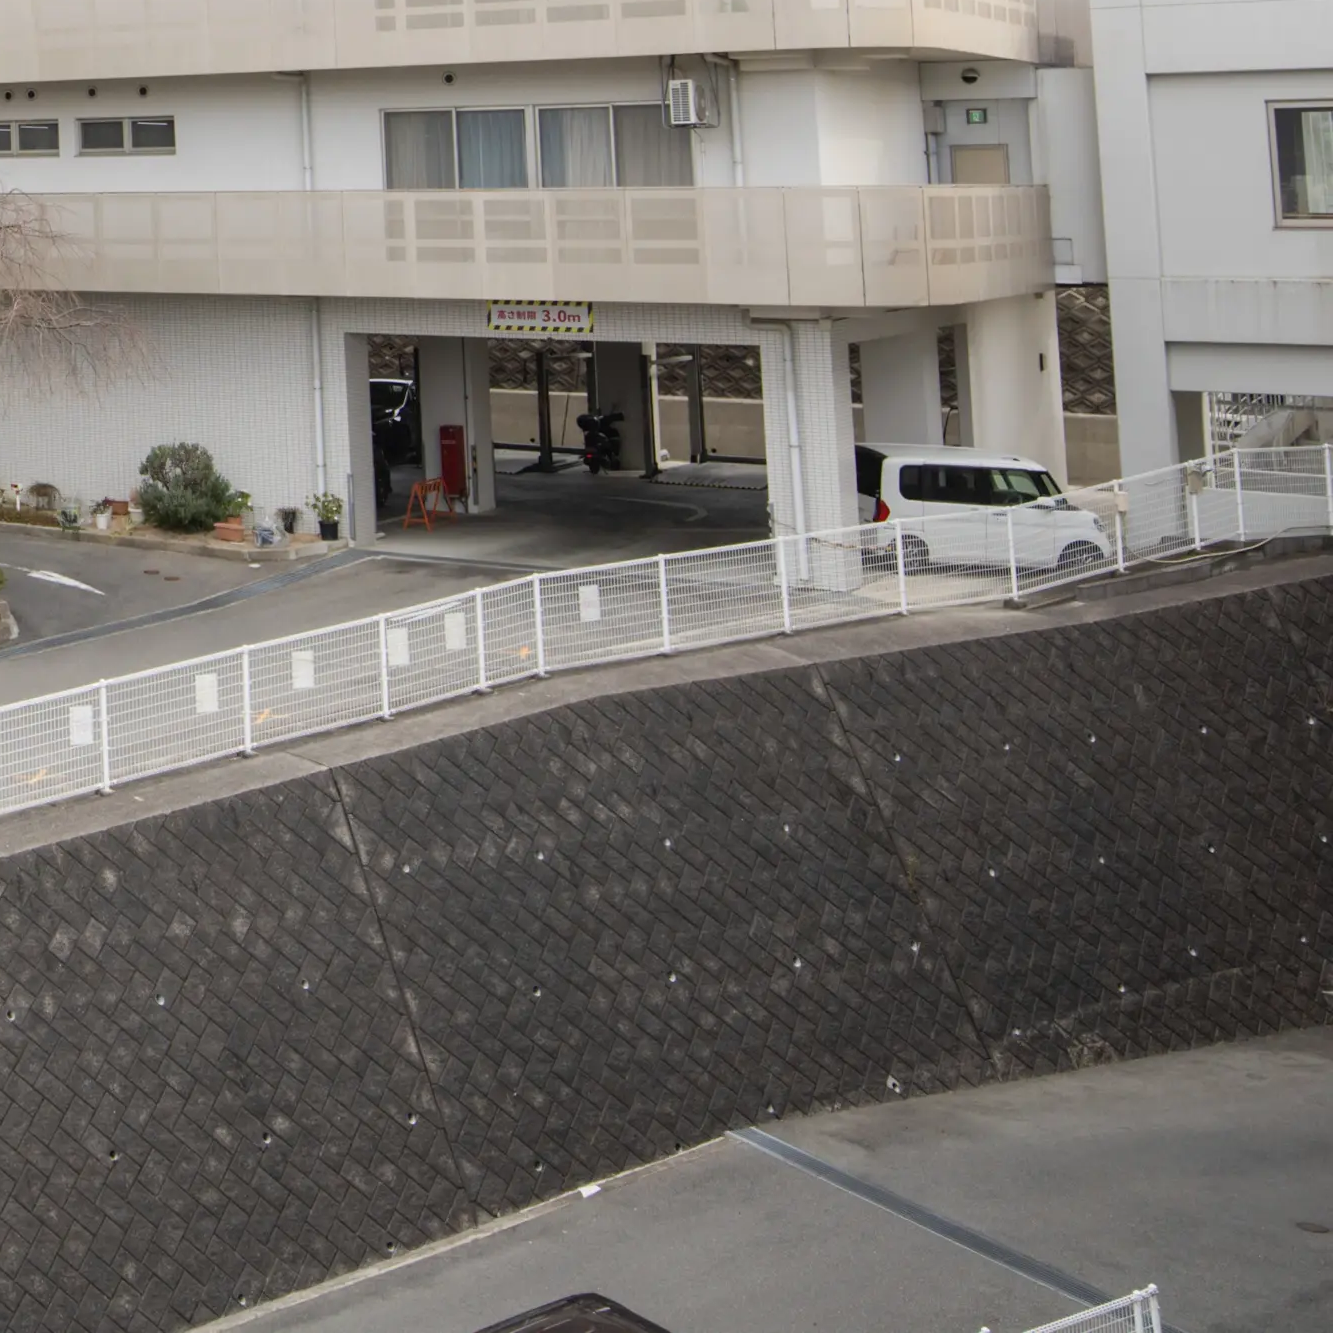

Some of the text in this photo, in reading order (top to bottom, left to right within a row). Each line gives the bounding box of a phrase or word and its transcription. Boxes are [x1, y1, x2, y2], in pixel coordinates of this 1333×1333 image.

[497, 309, 581, 323] 高さ制限 3.0m
